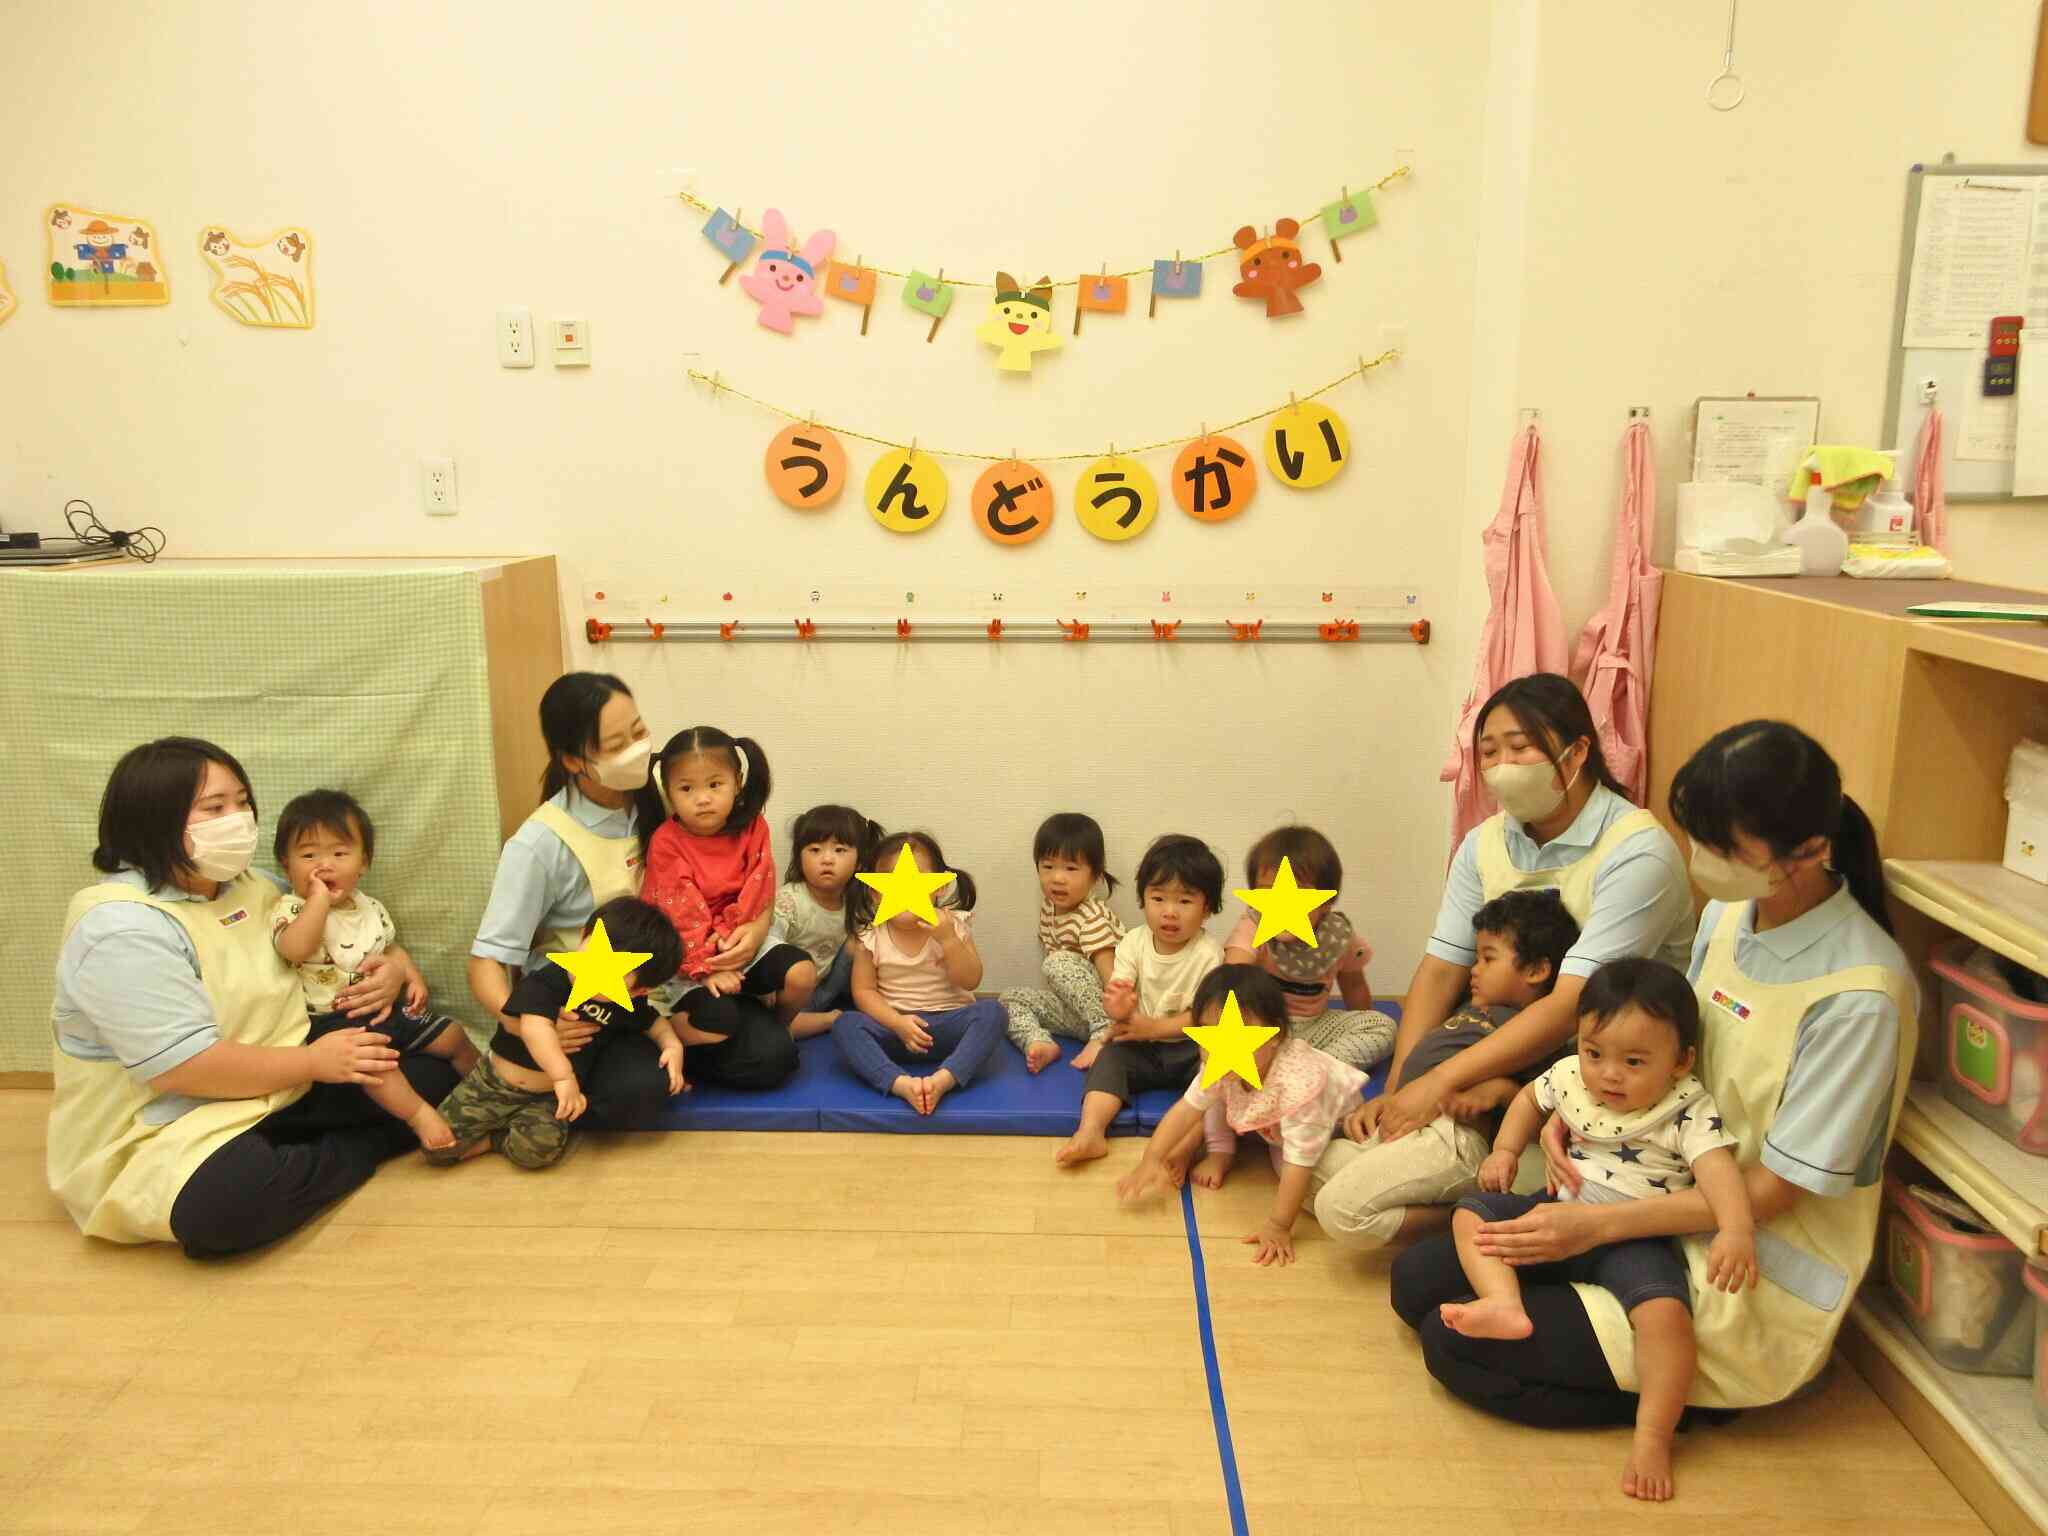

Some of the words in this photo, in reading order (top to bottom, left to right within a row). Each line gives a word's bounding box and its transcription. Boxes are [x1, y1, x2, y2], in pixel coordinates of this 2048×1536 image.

[781, 419, 1343, 536] うんどうかい
